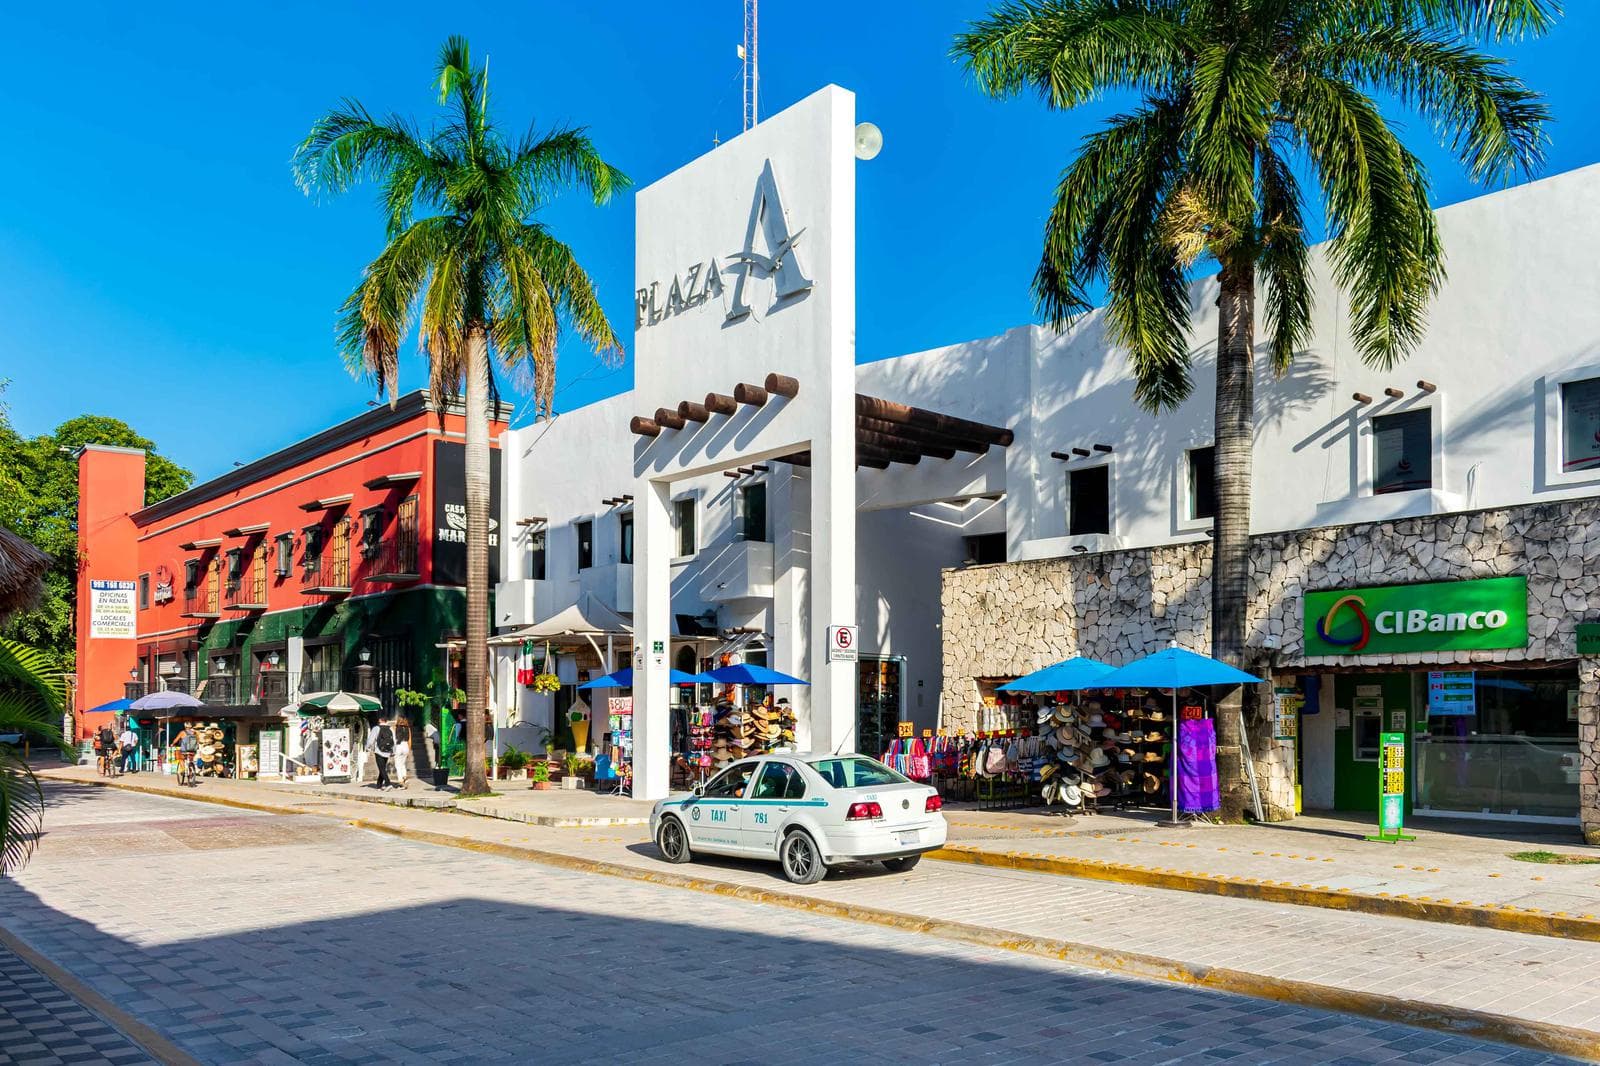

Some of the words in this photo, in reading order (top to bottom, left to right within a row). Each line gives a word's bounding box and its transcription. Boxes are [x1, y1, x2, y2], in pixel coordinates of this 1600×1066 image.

[635, 257, 725, 326] PLAZA
[723, 158, 814, 323] A
[444, 503, 466, 514] CASA
[1374, 608, 1509, 635] CIBanco
[711, 809, 727, 822] TAXI
[754, 812, 768, 824] 781
